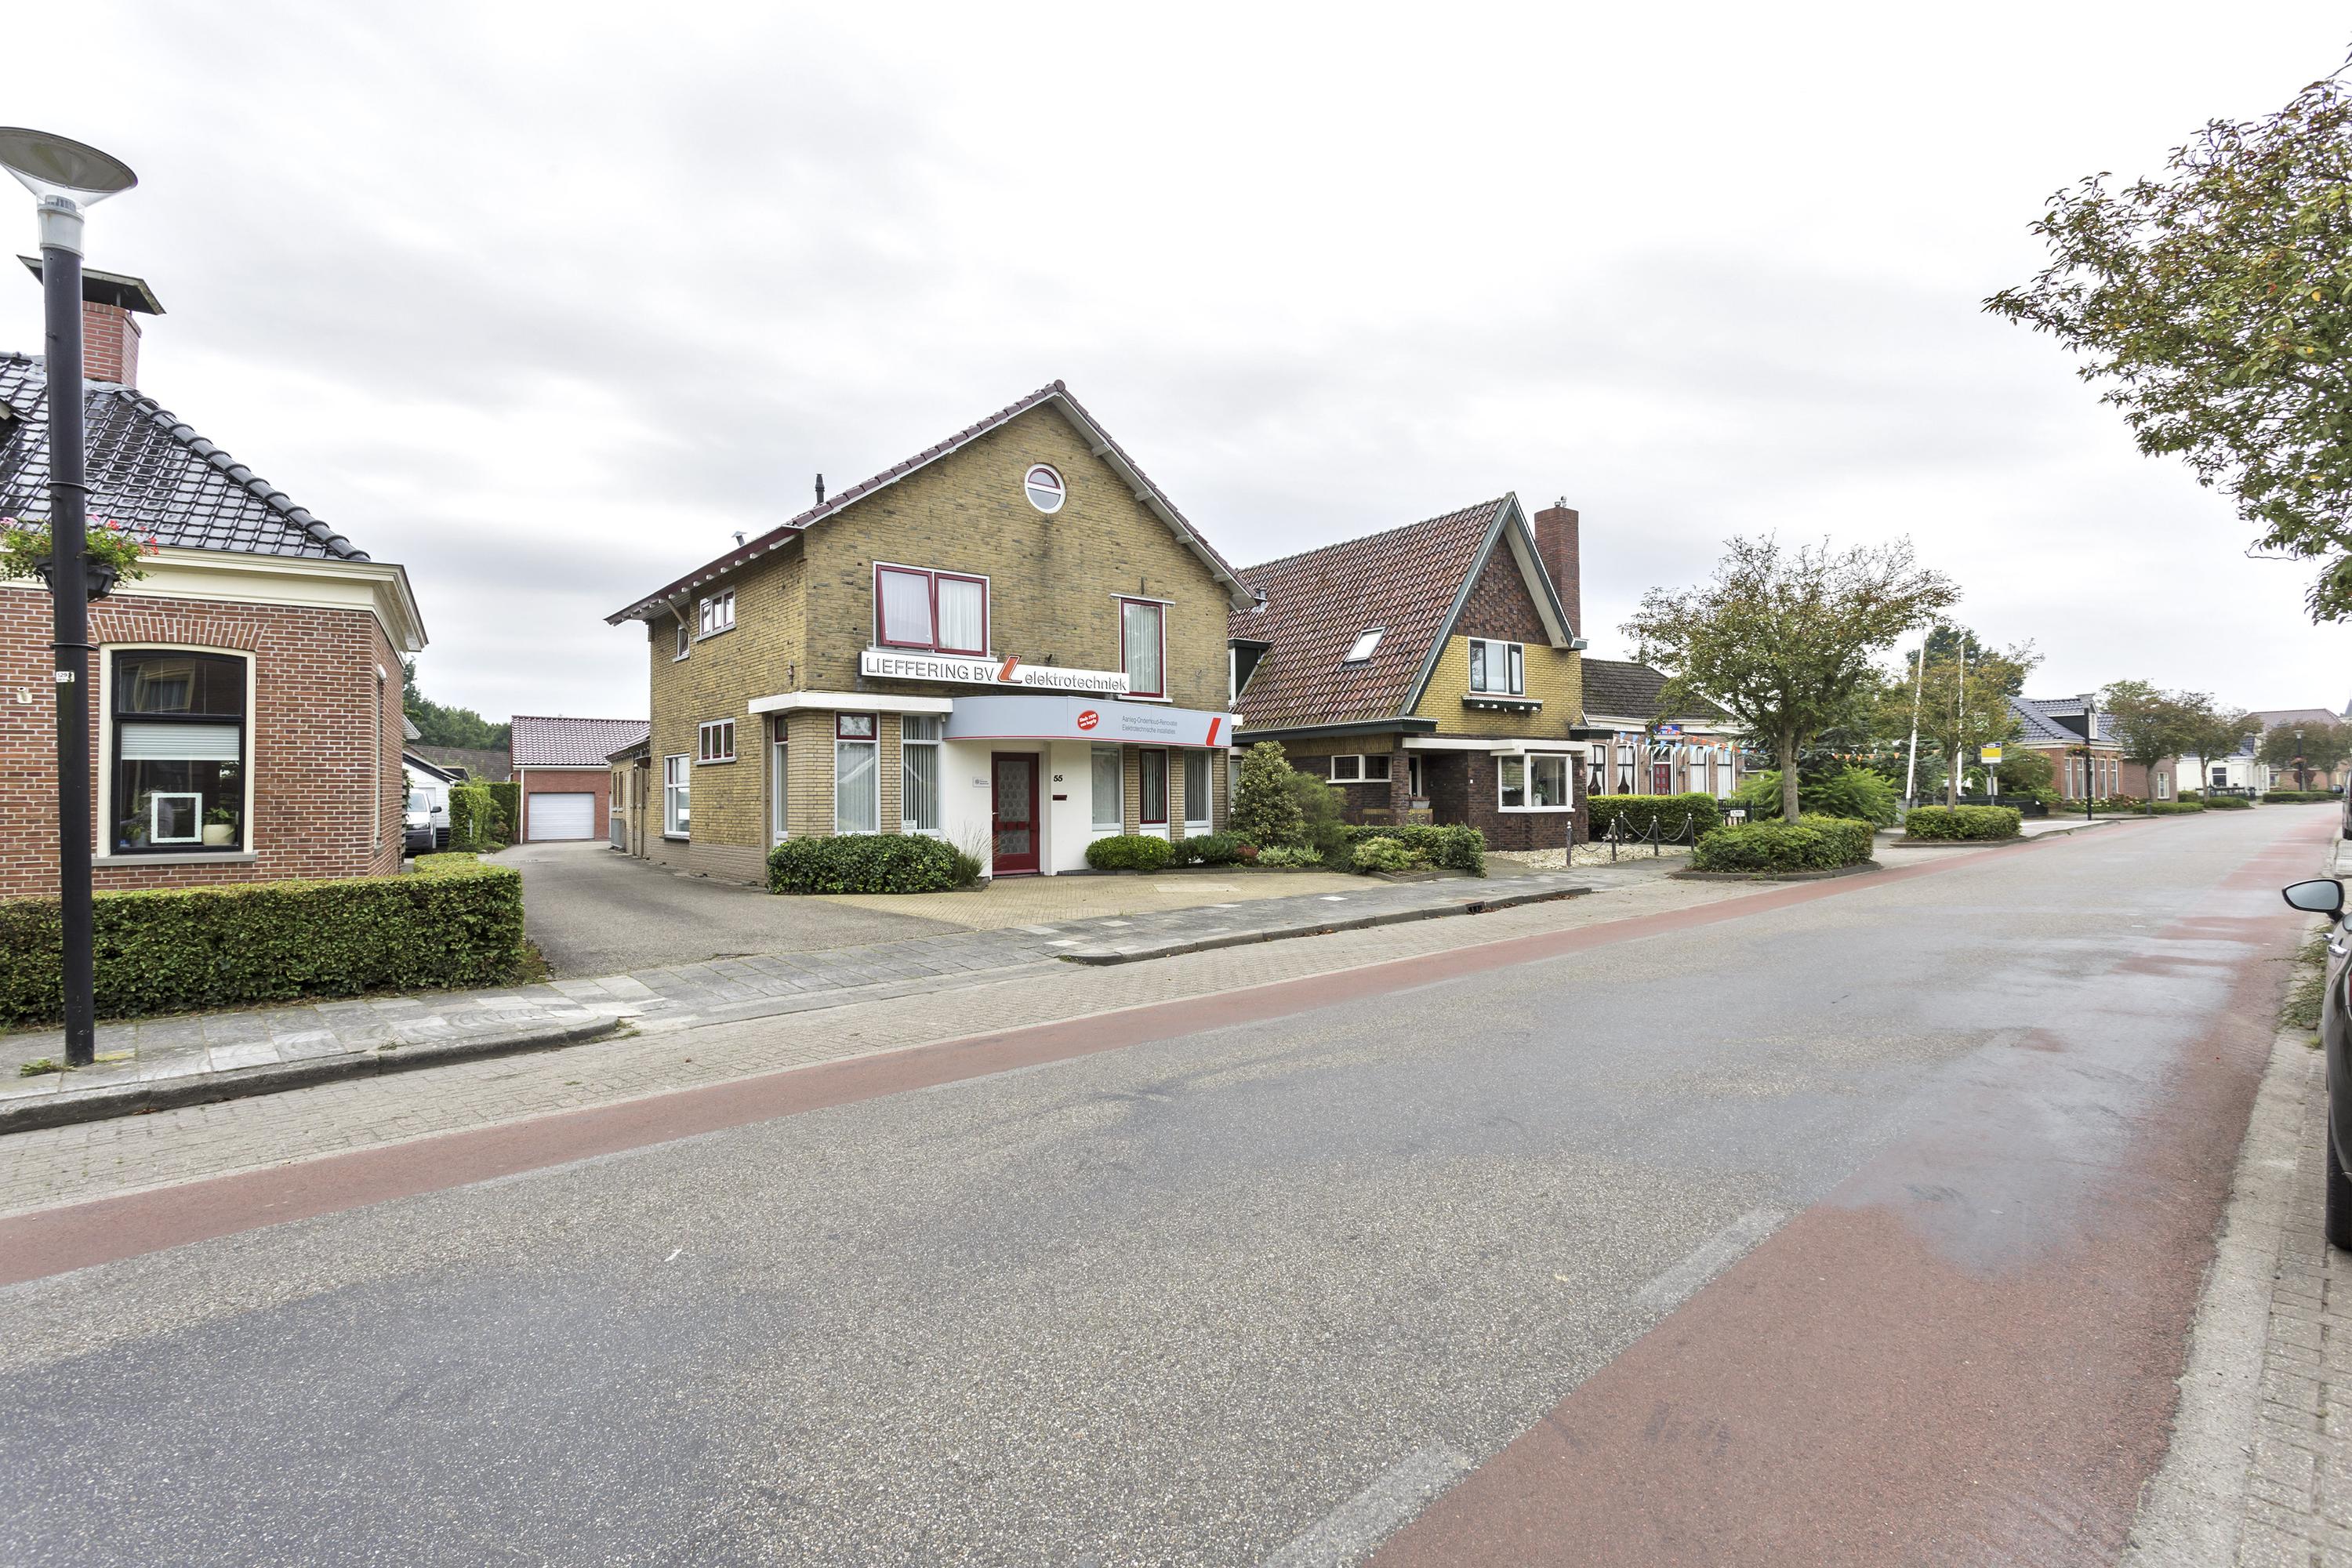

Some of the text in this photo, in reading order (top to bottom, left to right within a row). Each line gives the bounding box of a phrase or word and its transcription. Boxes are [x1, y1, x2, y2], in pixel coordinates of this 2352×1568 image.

[866, 657, 969, 680] LIEFFERING
[974, 666, 994, 681] BV
[1025, 671, 1127, 691] elektrotechniek
